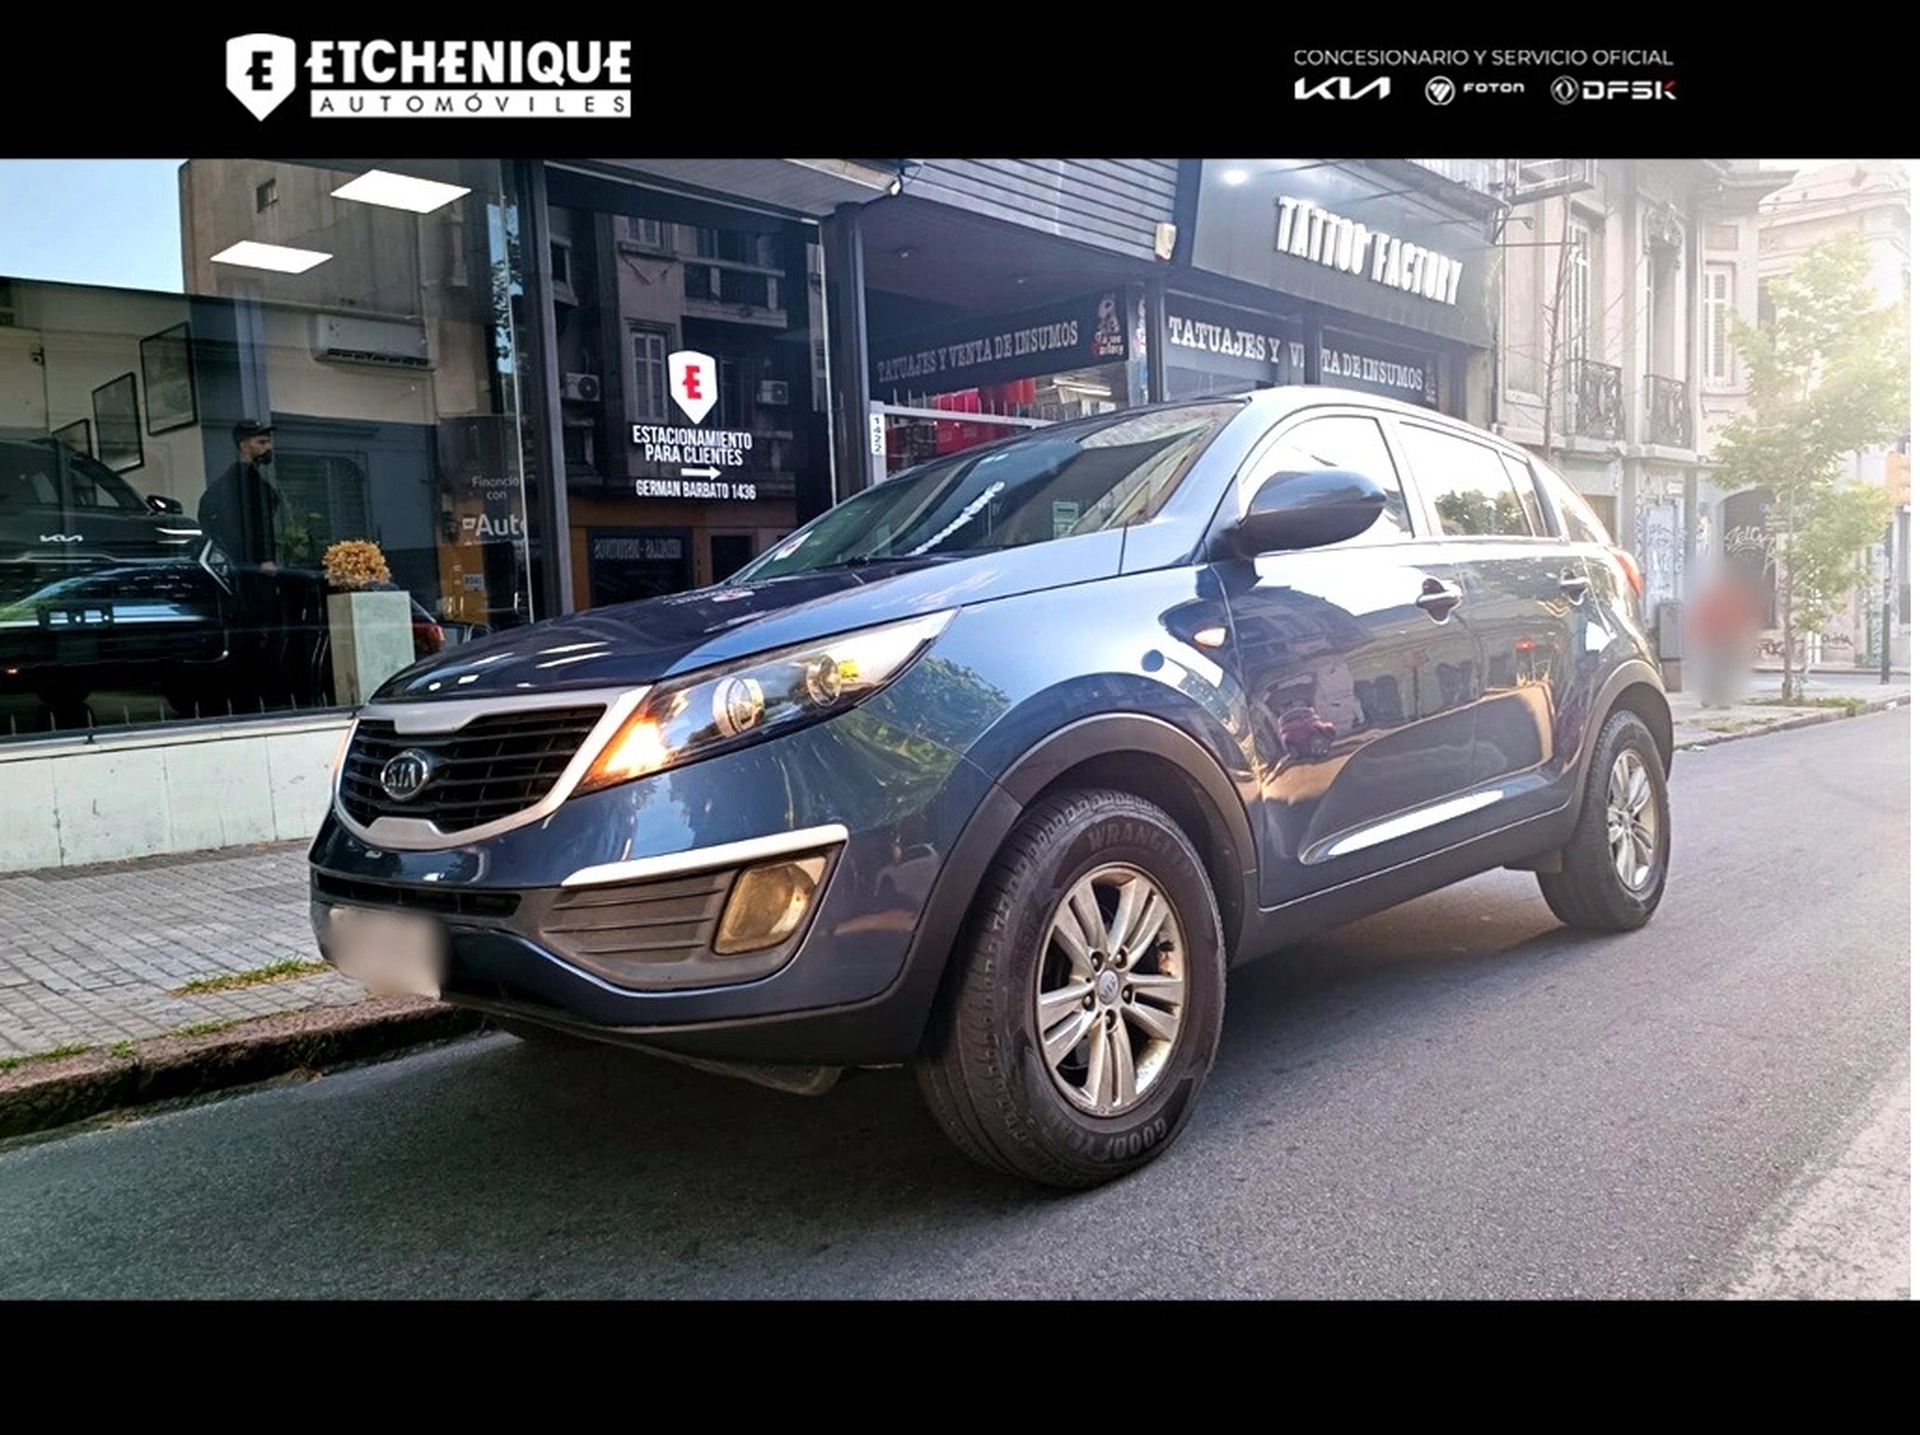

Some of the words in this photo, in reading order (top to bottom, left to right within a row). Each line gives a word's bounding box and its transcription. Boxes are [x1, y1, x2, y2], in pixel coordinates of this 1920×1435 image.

[1366, 231, 1464, 305] FACTORY
[877, 350, 937, 383] TATUAJES
[937, 348, 948, 370] Y
[949, 338, 992, 369] VENTA
[994, 334, 1013, 361] DE
[1014, 320, 1079, 356] INSUMOS
[1168, 316, 1267, 362] TATUAJES
[1268, 337, 1281, 363] Y
[1343, 354, 1361, 378] DE
[1363, 359, 1424, 390] INSUMOS
[682, 365, 702, 399] E
[632, 424, 753, 450] ESTACIONAMIENTO
[645, 443, 681, 463] PARA
[683, 446, 743, 466] CLIENTES
[636, 479, 681, 498] GERMAN
[682, 481, 729, 500] BARBATO
[731, 484, 757, 500] 1436
[387, 762, 417, 788] KIA
